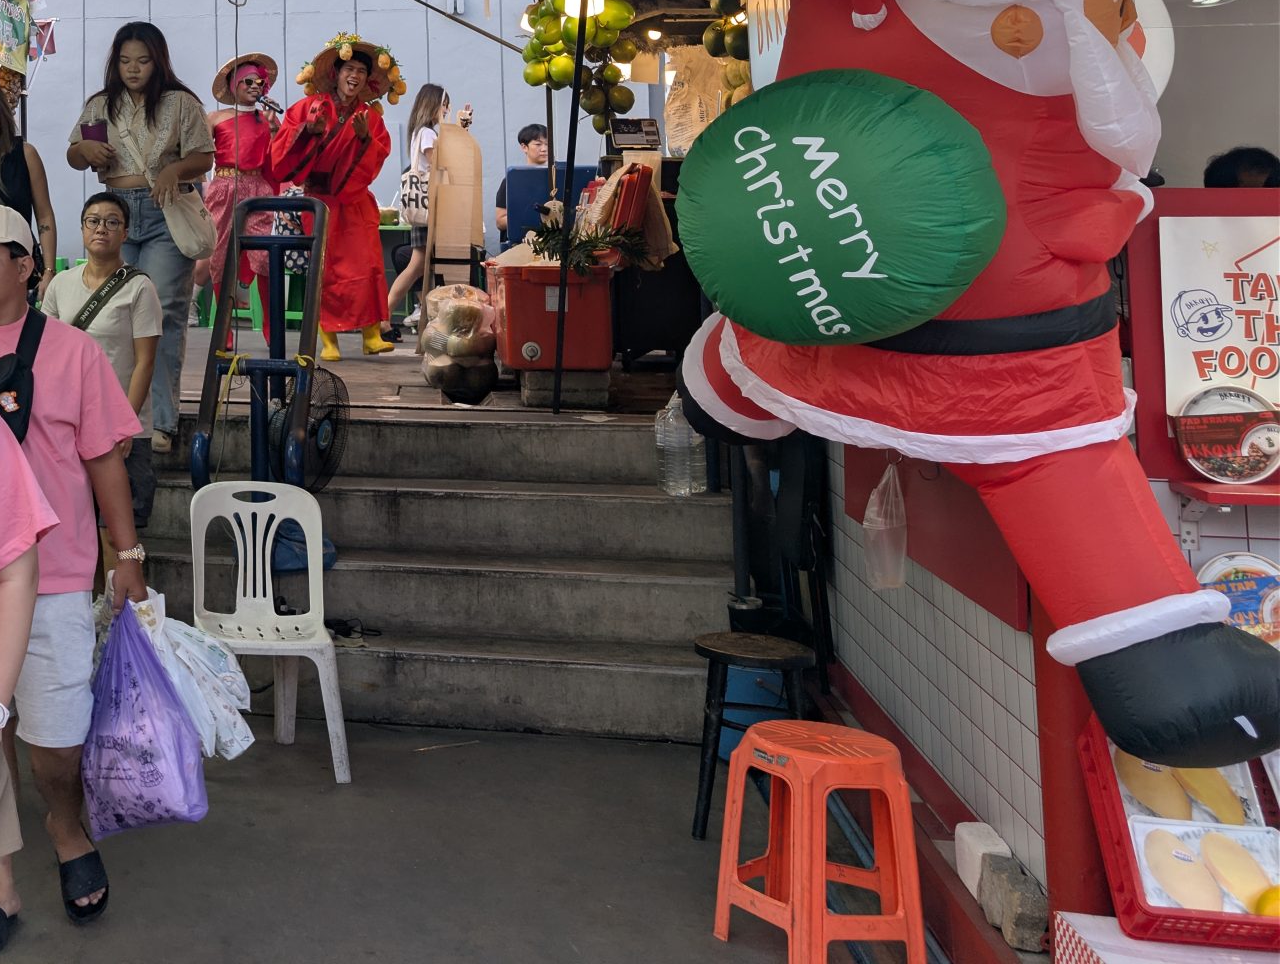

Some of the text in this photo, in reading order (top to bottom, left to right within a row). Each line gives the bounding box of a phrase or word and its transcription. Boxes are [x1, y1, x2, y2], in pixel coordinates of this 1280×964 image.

[791, 135, 889, 279] Merry
[733, 125, 852, 336] Christmas
[99, 277, 119, 297] CELINE
[1223, 272, 1280, 305] TA
[79, 300, 98, 322] CELINE
